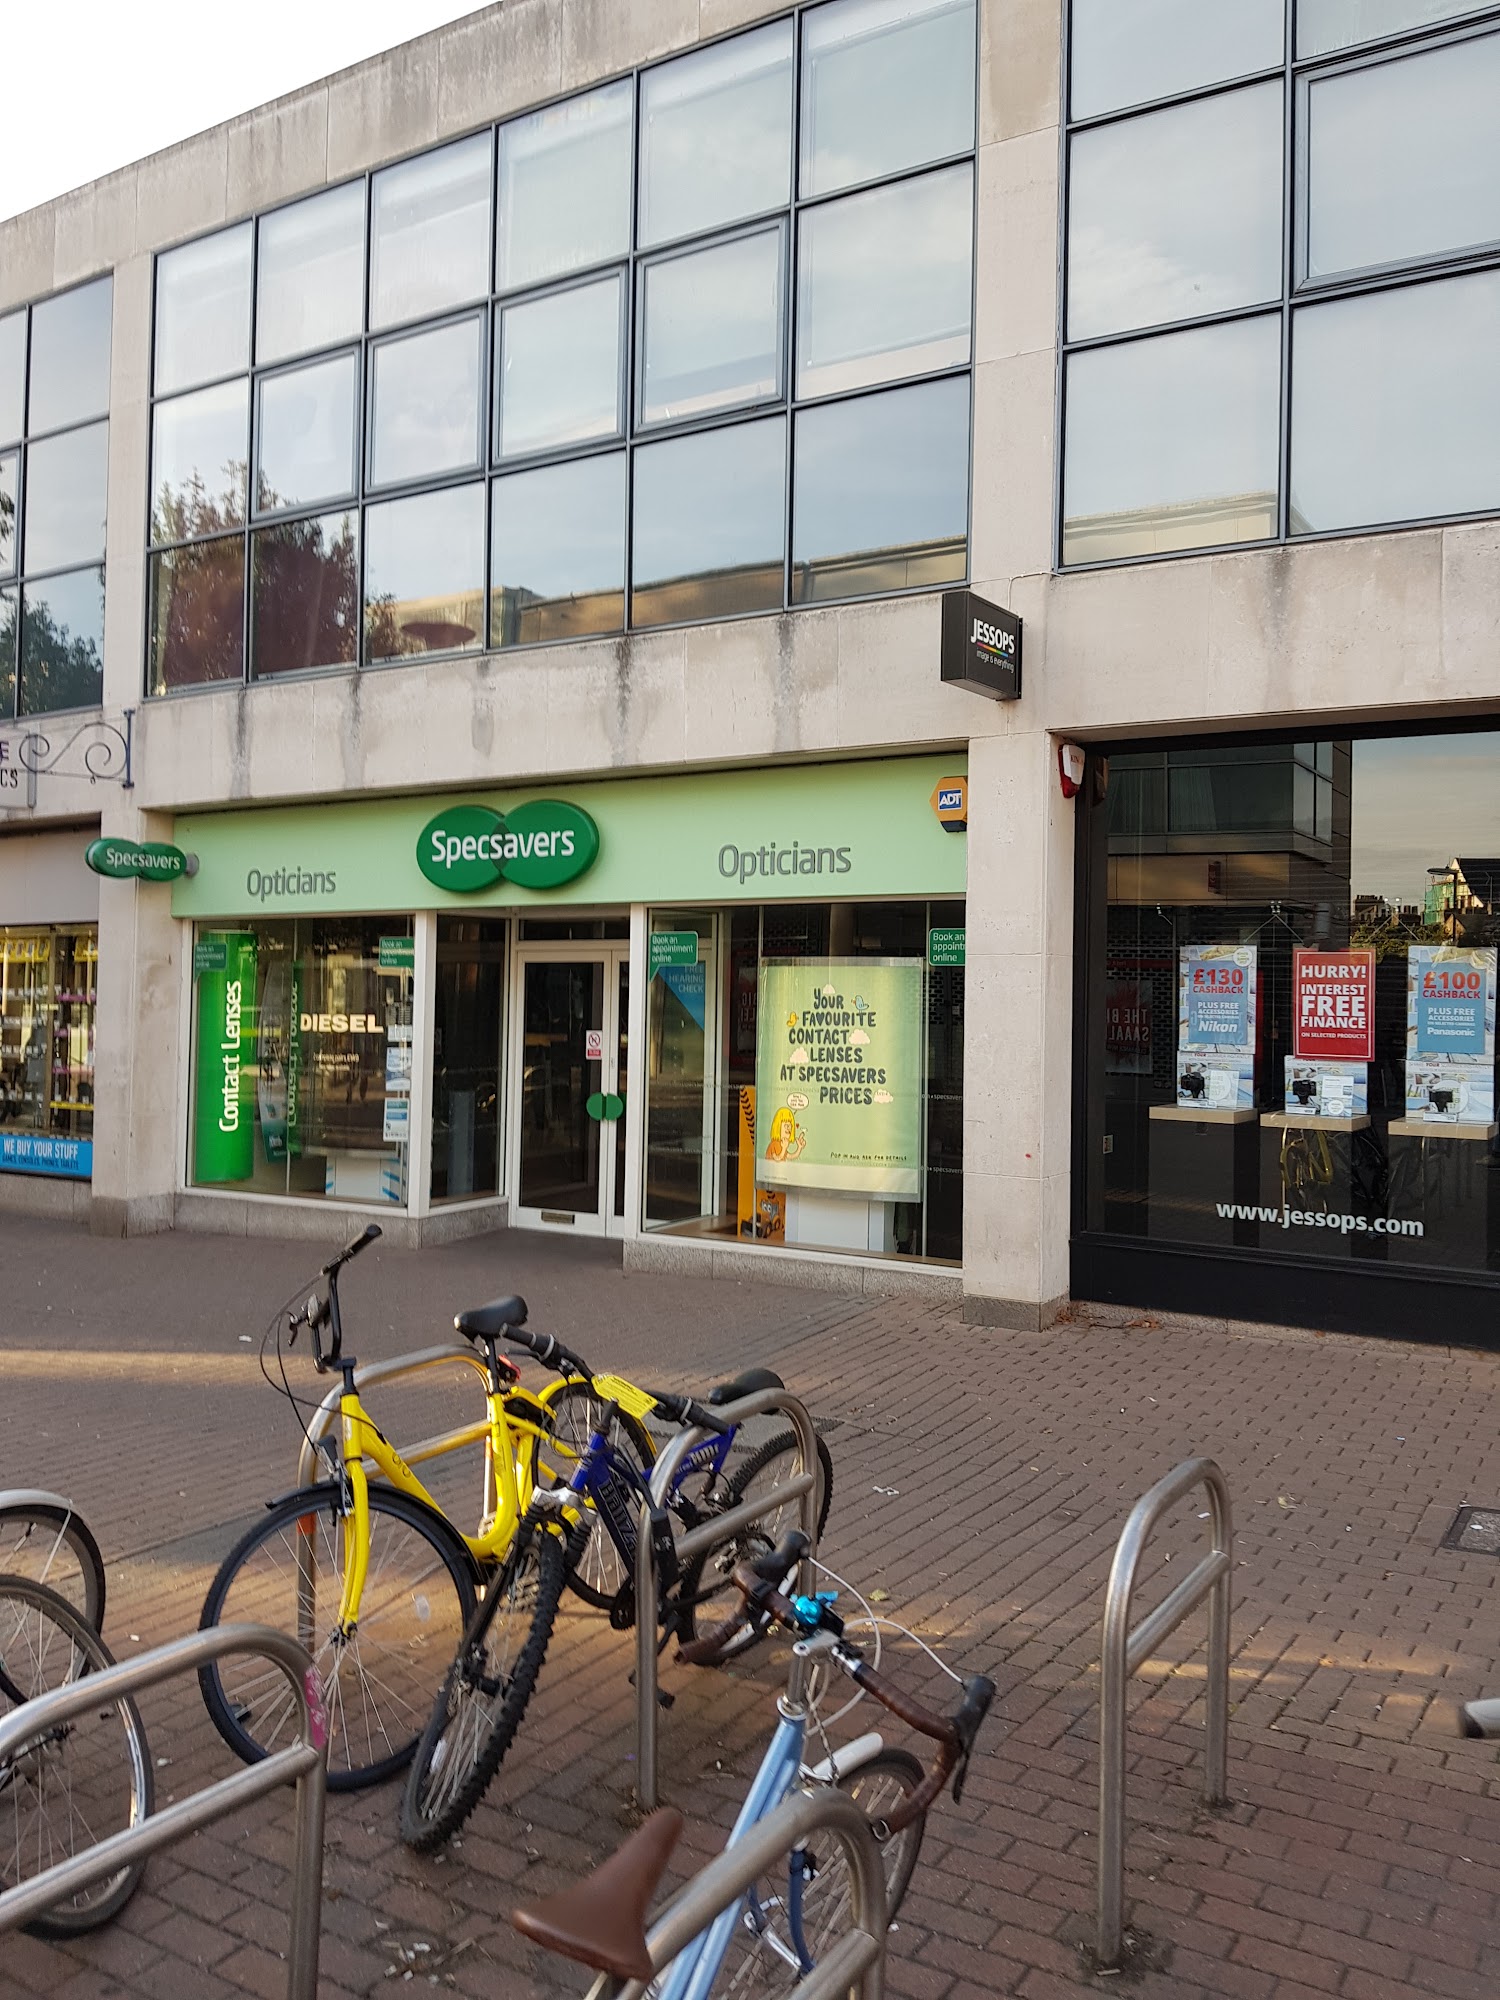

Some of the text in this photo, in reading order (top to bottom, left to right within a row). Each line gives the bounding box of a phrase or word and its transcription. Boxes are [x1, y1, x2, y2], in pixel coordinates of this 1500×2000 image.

[971, 618, 1015, 654] JESSOPS
[976, 647, 989, 663] image
[938, 792, 962, 808] ADT
[431, 830, 575, 869] Specsavers
[106, 847, 181, 871] Specsavers
[718, 841, 852, 885] Opticians
[247, 866, 337, 903] Opticians
[652, 935, 668, 945] Book
[933, 932, 965, 941] Book an
[652, 944, 693, 954] appointment
[652, 954, 672, 963] online
[933, 953, 957, 962] online
[669, 974, 704, 983] HEARING
[1193, 968, 1244, 986] £130
[1301, 965, 1367, 979] HURRY!
[678, 984, 703, 993] CHECK
[1423, 971, 1481, 990] £100
[1193, 985, 1244, 994] CASHBACK
[1301, 984, 1366, 995] INTEREST
[1422, 990, 1481, 998] CASHBACK
[813, 988, 844, 1009] YOUR
[1198, 1001, 1218, 1009] PLUS
[1302, 995, 1366, 1017] FREE
[1428, 1007, 1452, 1015] PLUS
[300, 1013, 384, 1034] DIESEL
[1198, 1021, 1238, 1032] Nikon
[1301, 1016, 1366, 1029] FINANCE
[788, 1028, 850, 1044] CONTACT
[1427, 1027, 1475, 1036] Panasonic
[219, 980, 241, 1132] Contact Lenses
[810, 1046, 863, 1063] LENSES
[780, 1064, 886, 1085] AT SPECSAVERS
[820, 1086, 872, 1105] PRICES
[3, 1138, 79, 1160] WE BUY YOUR STUFF
[1216, 1203, 1424, 1237] www.jessops.com
